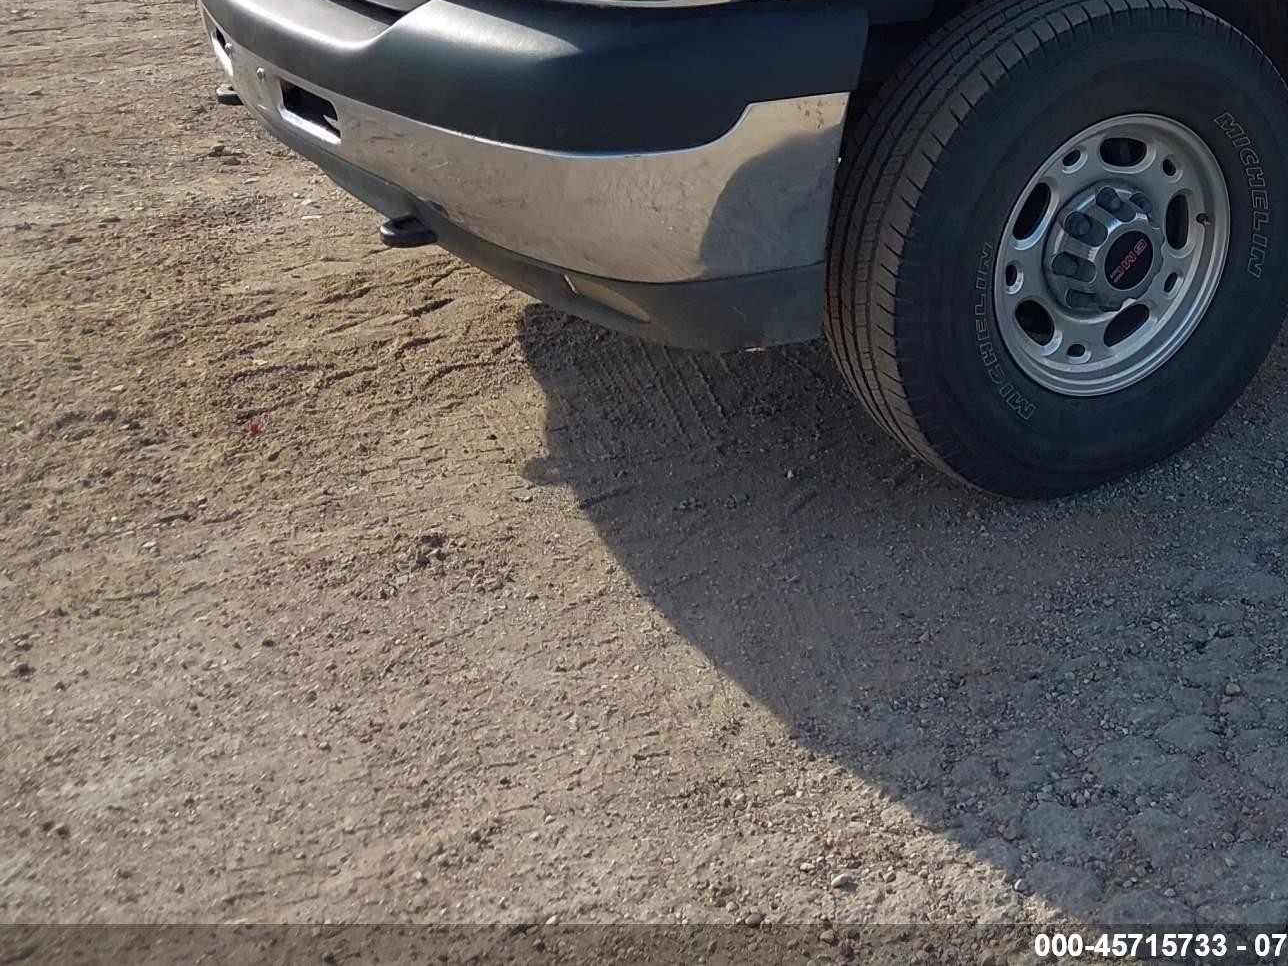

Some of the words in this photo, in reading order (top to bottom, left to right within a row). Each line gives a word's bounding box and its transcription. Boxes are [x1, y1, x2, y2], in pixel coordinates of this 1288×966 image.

[1110, 238, 1147, 283] GMC
[1213, 112, 1270, 279] MICHELIN
[974, 241, 1037, 421] MICHELIN
